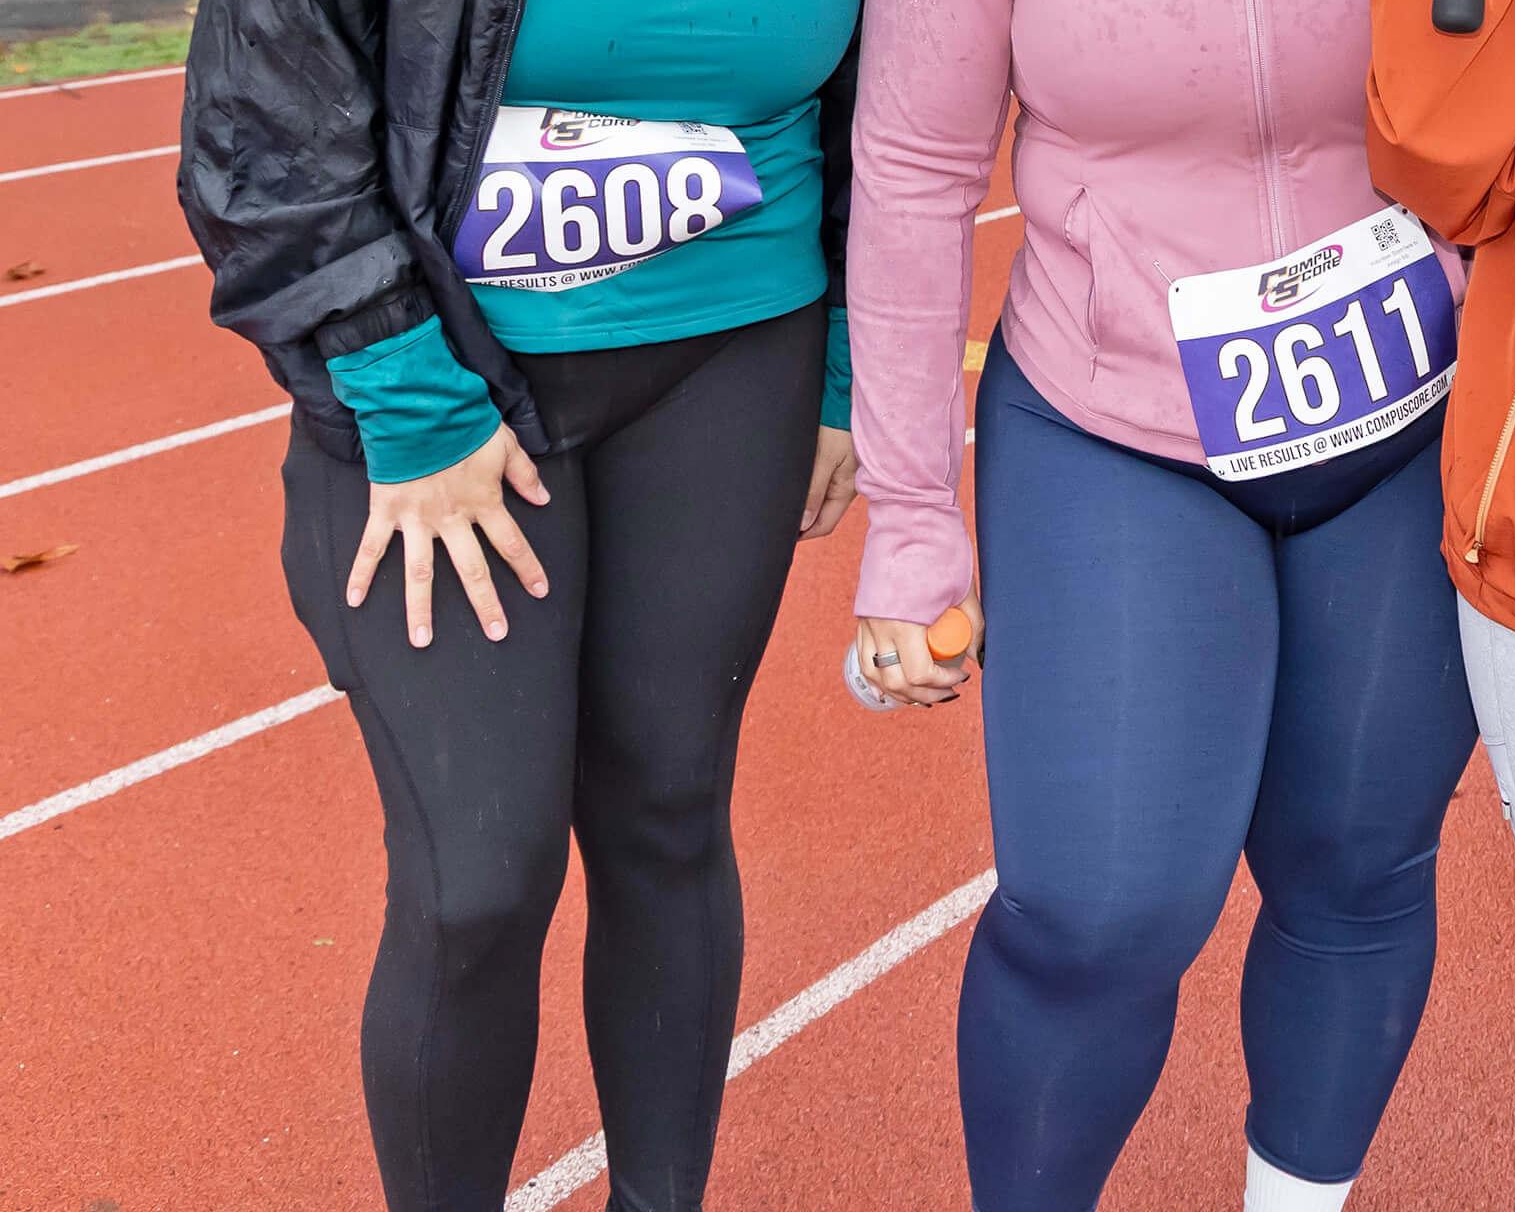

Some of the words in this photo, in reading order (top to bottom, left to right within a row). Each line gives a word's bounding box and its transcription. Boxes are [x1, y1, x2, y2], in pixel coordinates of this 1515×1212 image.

[477, 156, 724, 272] 2608
[561, 273, 575, 285] @
[1258, 248, 1333, 296] COMPU
[1272, 255, 1341, 304] SCORE
[1217, 276, 1431, 443] 2611
[1230, 455, 1257, 474] LIVE
[1259, 442, 1311, 468] RESULTS
[1313, 437, 1327, 454] @
[1329, 374, 1448, 449] WWW.COMPUSCORE.COM
